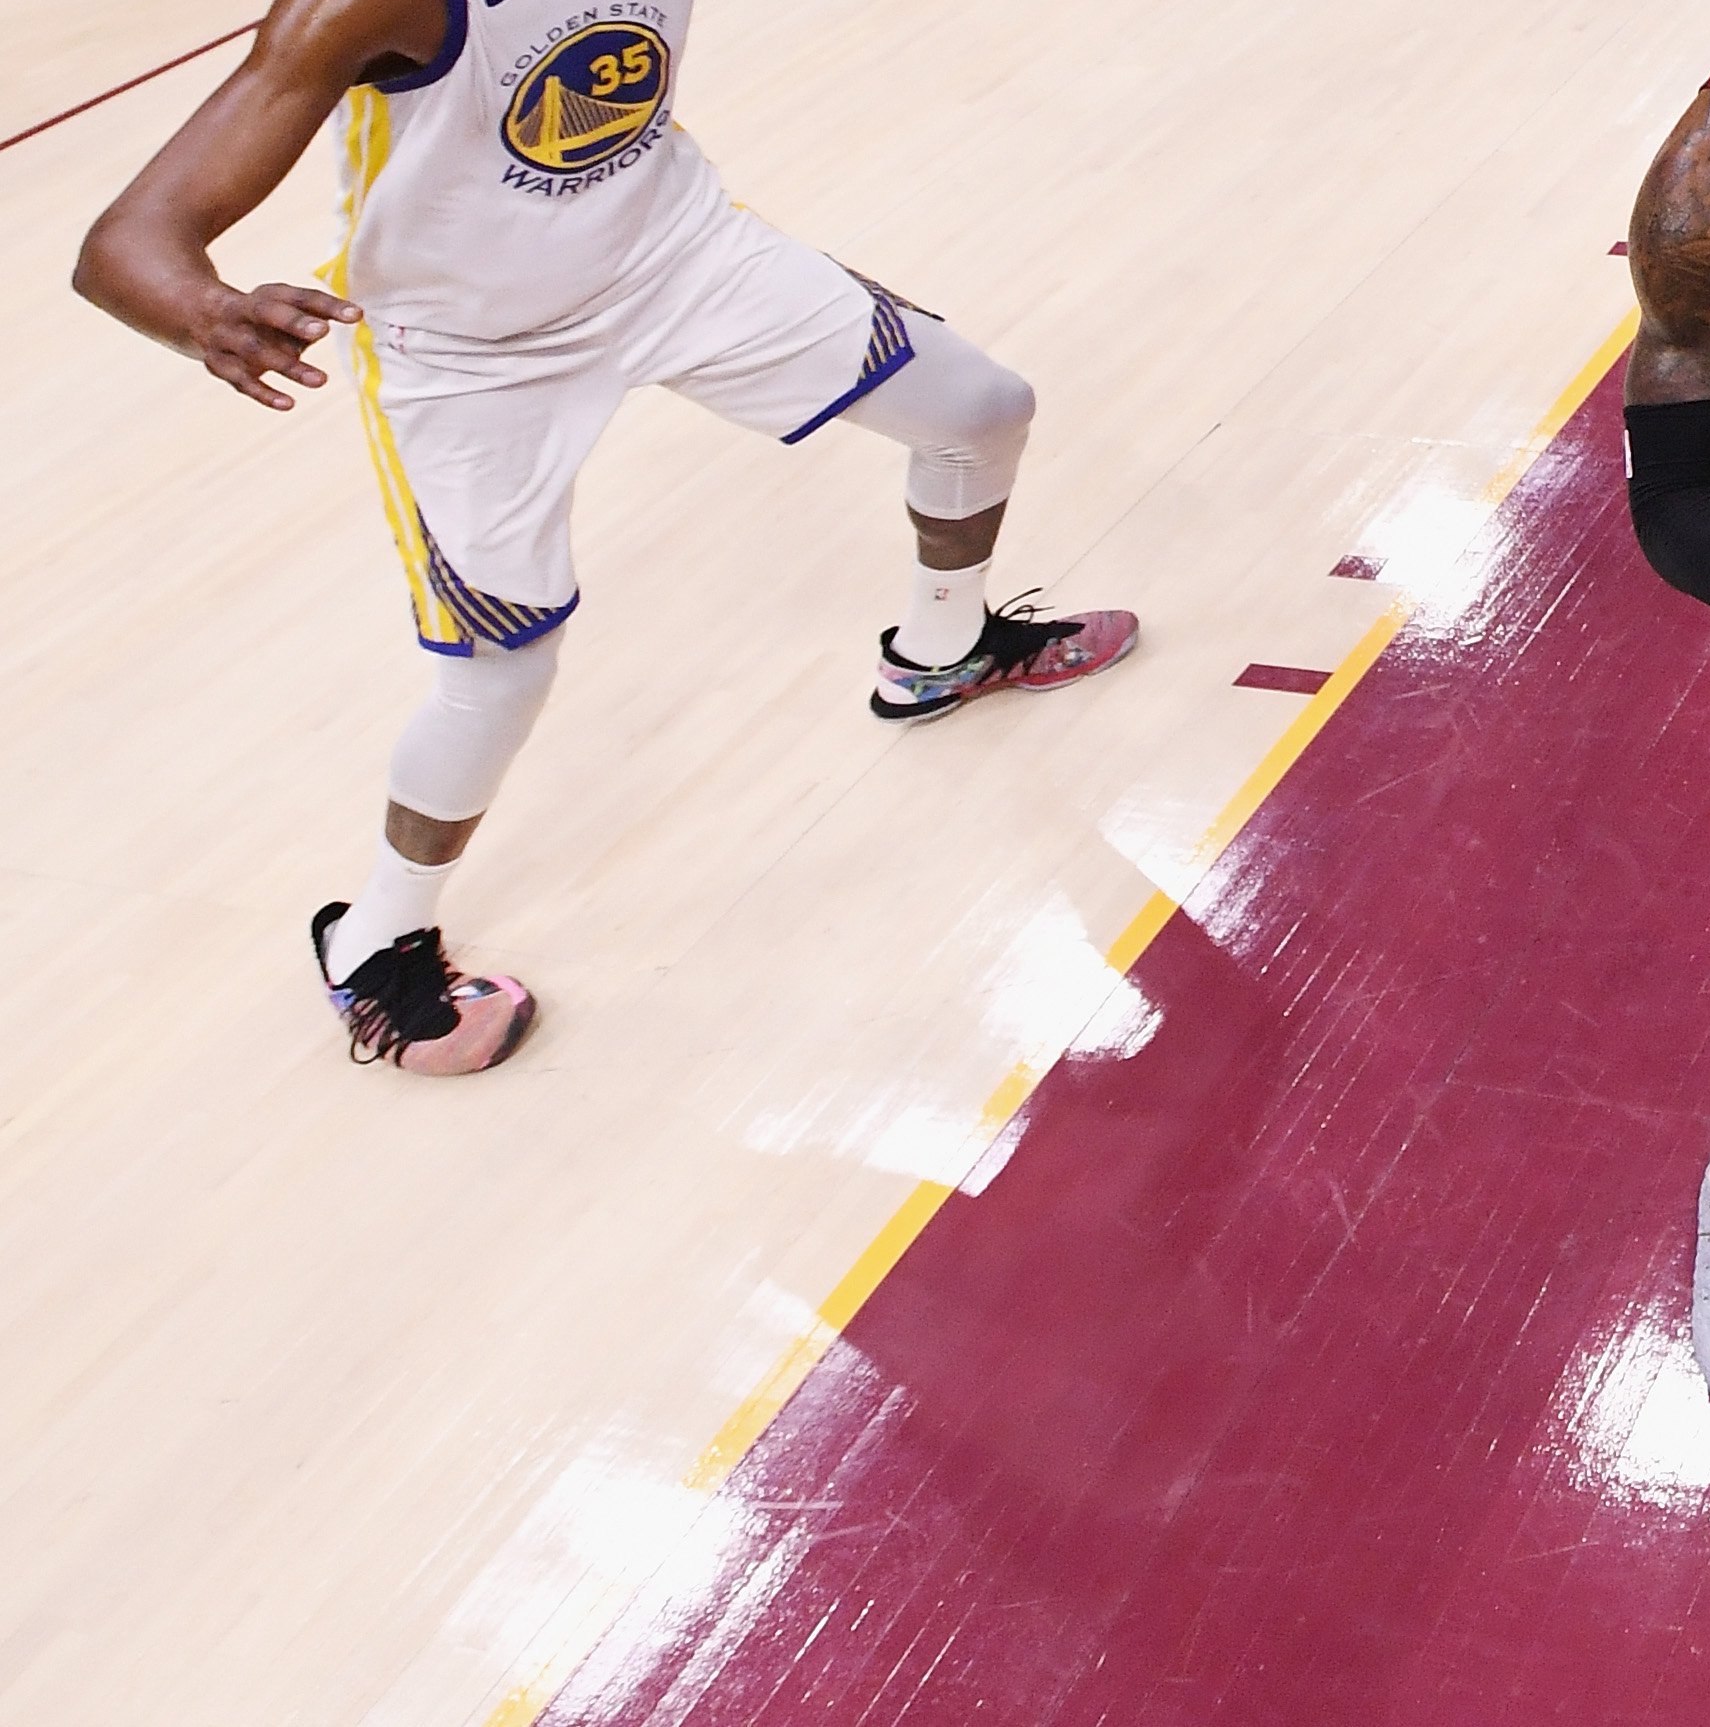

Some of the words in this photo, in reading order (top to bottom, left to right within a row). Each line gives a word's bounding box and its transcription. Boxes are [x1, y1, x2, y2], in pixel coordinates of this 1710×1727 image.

[501, 6, 600, 89] GOLDEN
[610, 1, 669, 29] STATE
[588, 40, 653, 98] 35
[501, 106, 672, 198] WARRIORS
